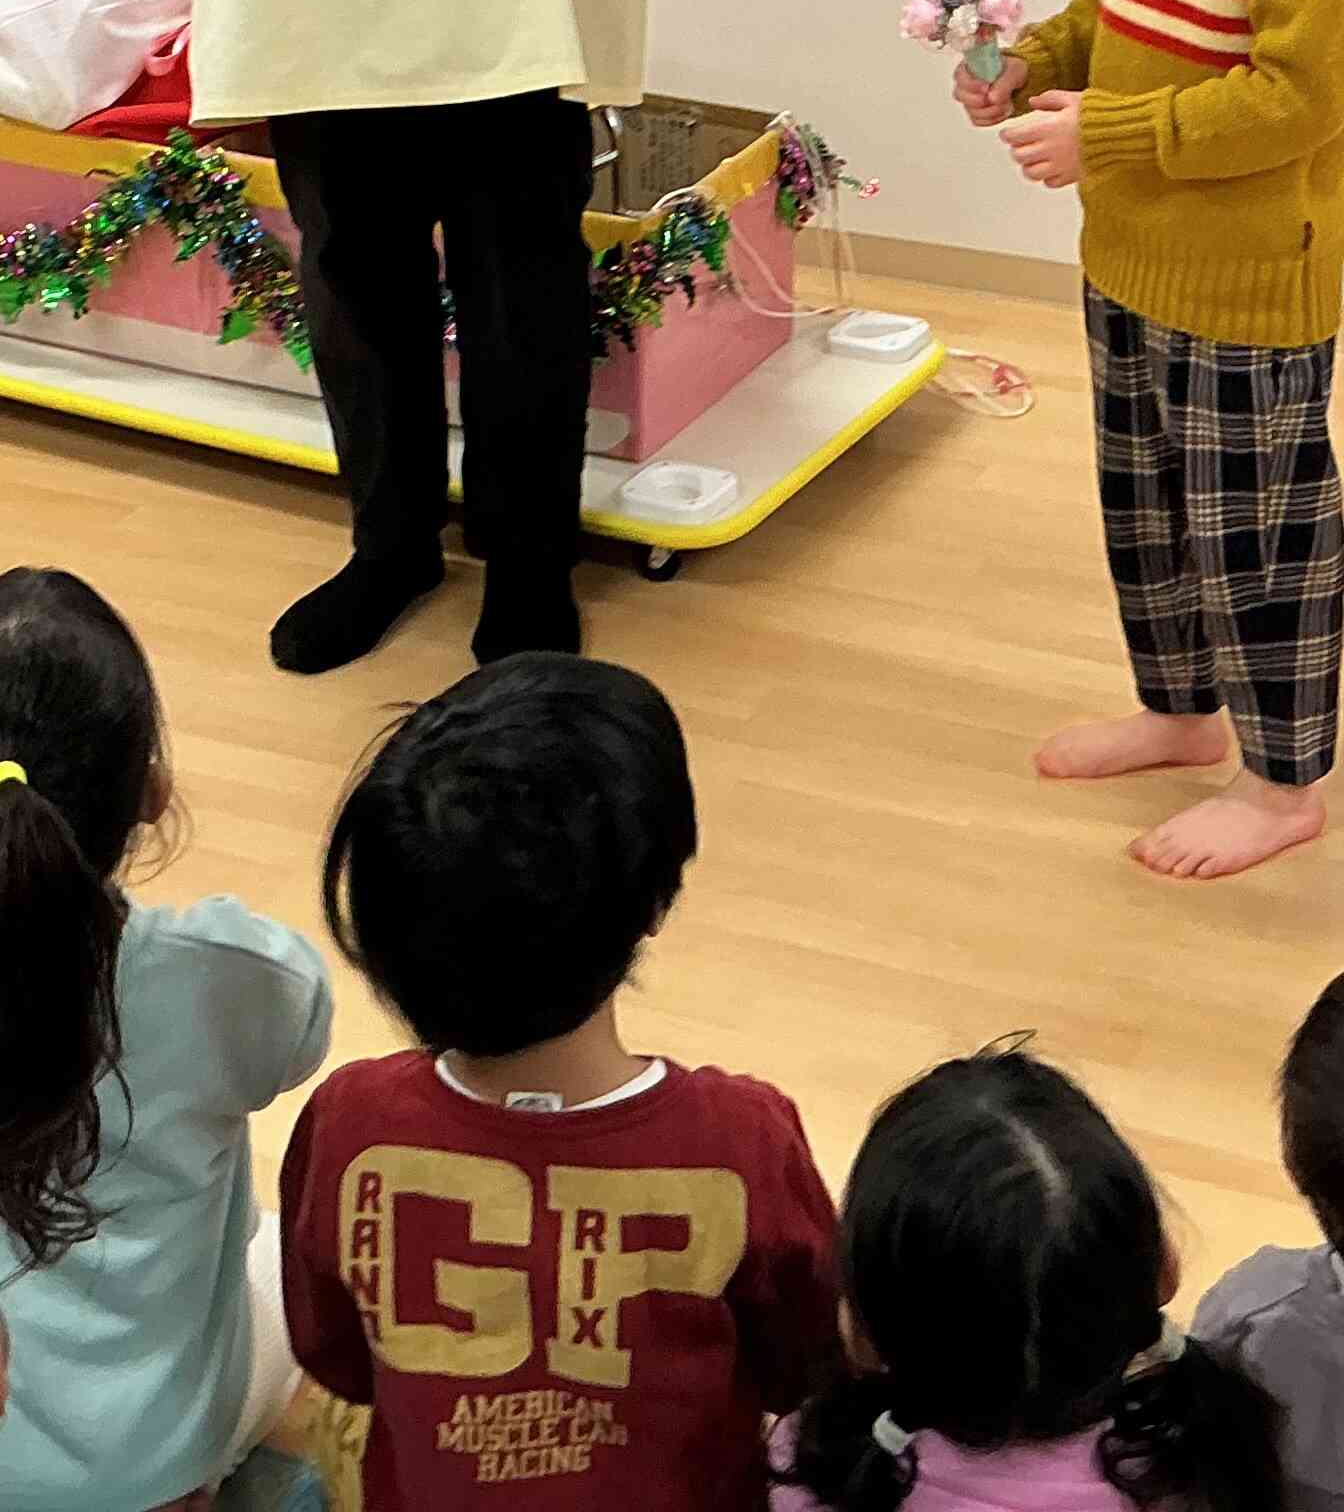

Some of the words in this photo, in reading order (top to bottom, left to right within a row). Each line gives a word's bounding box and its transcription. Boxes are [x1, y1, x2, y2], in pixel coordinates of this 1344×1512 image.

[339, 1144, 747, 1387] GP
[574, 1209, 608, 1347] RIX
[451, 1390, 614, 1425] AMERICAN
[436, 1417, 561, 1454] MUSCLE
[477, 1441, 592, 1482] RACING
